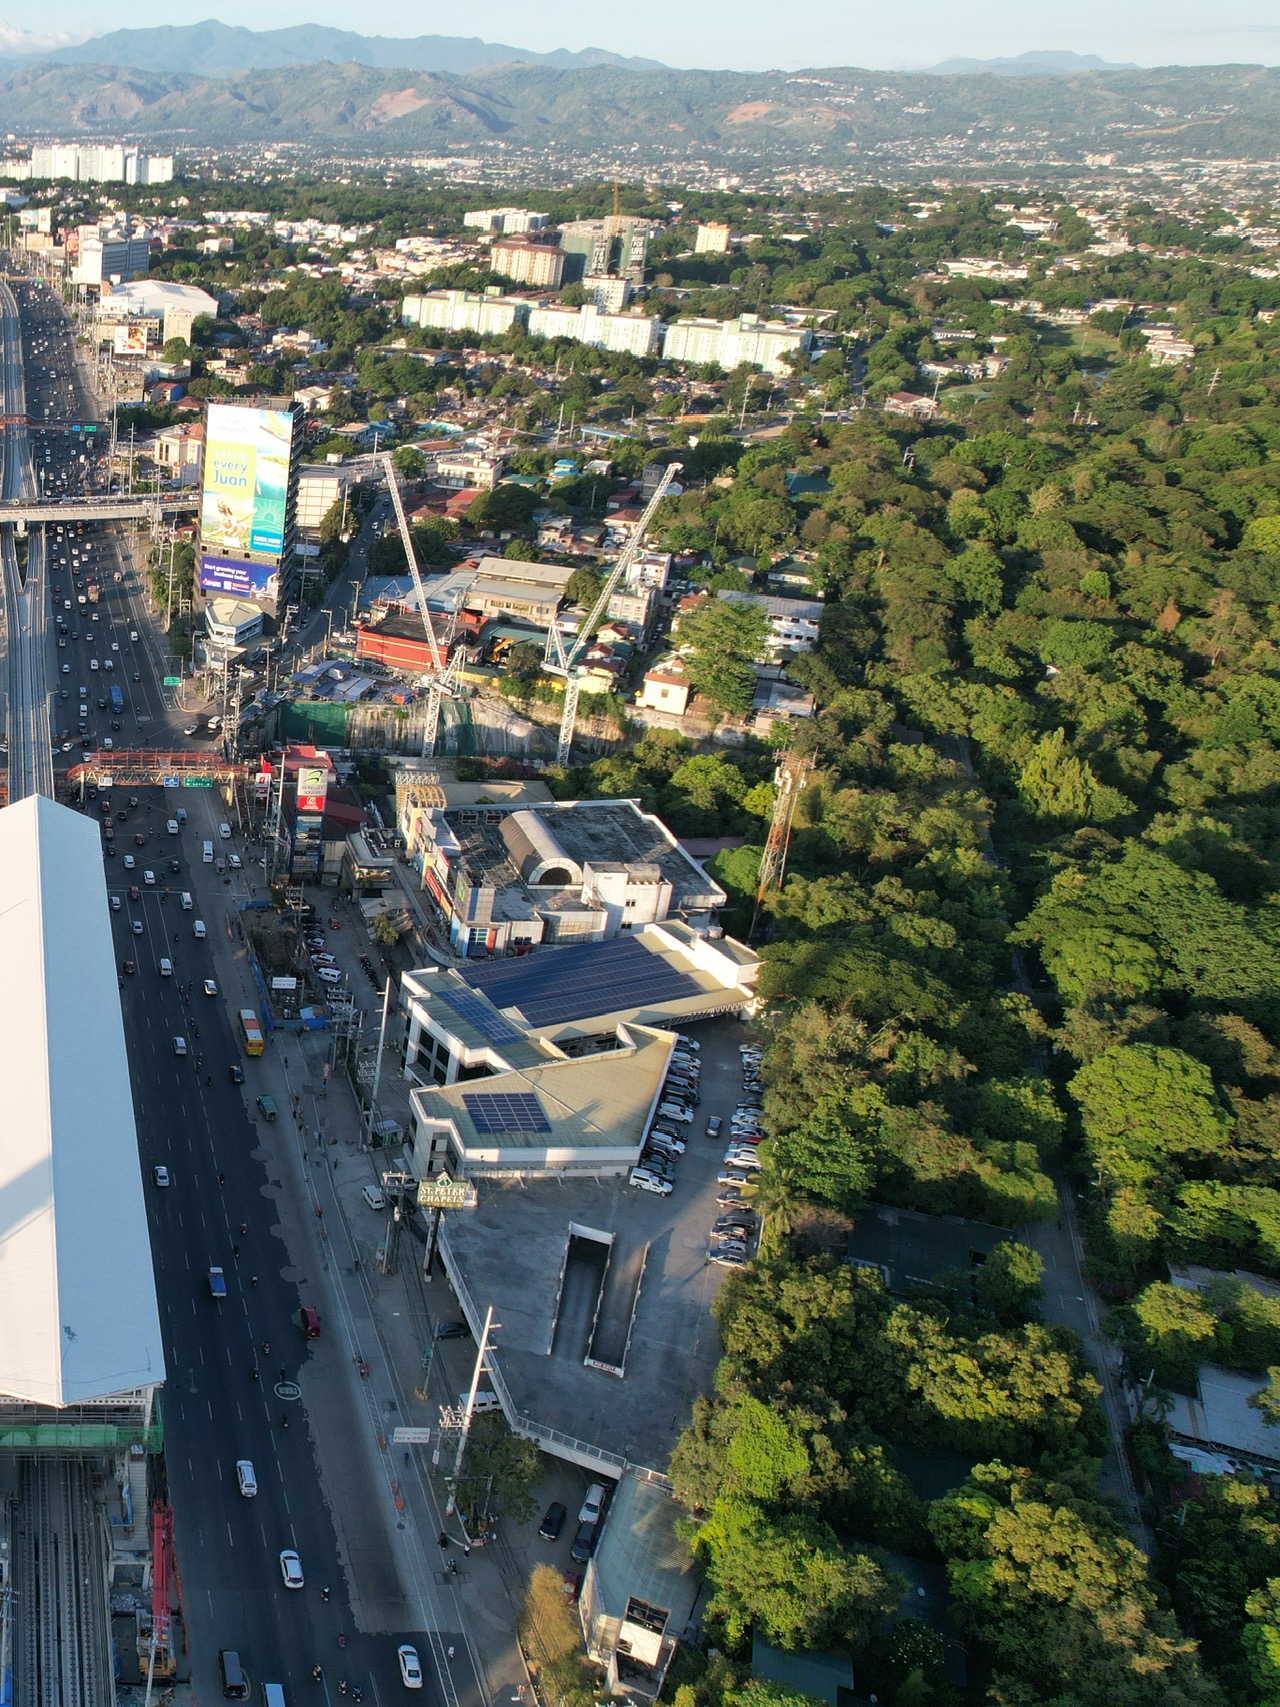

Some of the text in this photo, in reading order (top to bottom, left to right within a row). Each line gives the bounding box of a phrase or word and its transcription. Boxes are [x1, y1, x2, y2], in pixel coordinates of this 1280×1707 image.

[213, 460, 247, 475] every
[212, 469, 247, 487] Juan
[204, 563, 216, 571] Start
[216, 565, 235, 575] growing
[213, 571, 250, 582] business today!
[420, 1186, 466, 1197] ST. PETER
[420, 1195, 465, 1203] CHAPELS
